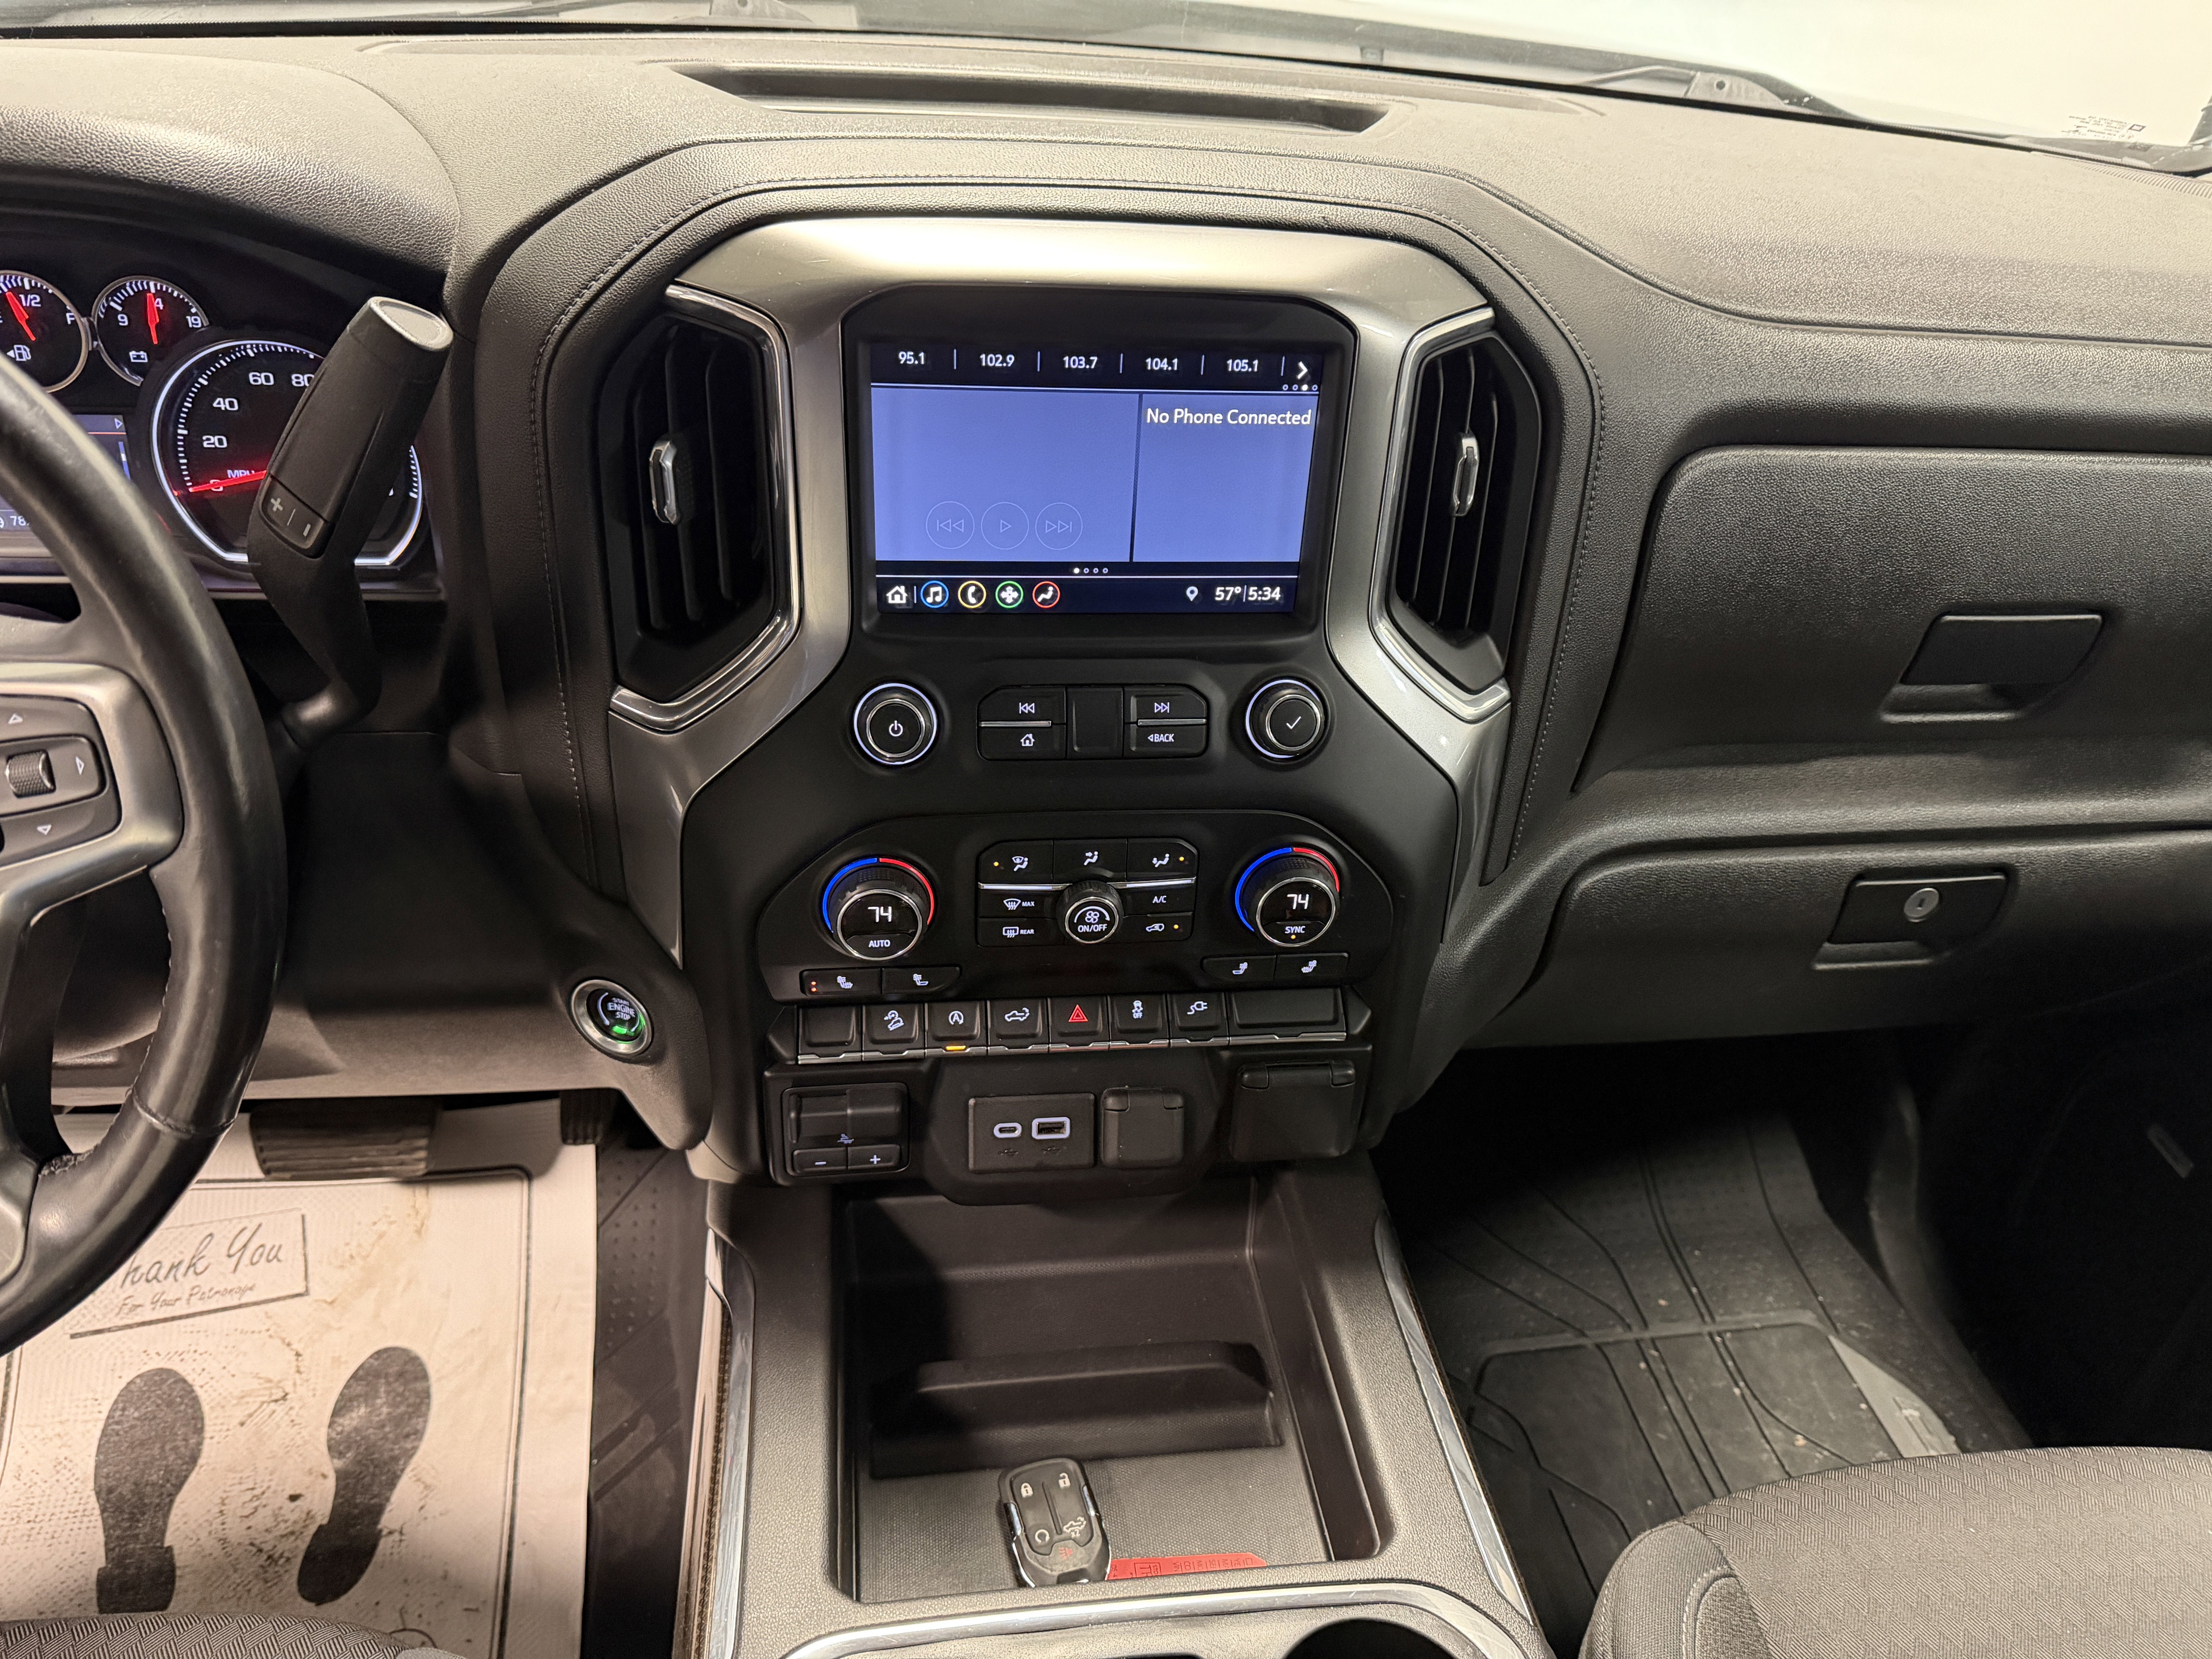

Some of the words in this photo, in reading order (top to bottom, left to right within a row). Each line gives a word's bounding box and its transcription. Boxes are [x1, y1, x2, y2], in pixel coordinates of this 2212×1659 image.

[19, 294, 41, 307] 1/2
[66, 313, 75, 325] F
[117, 314, 129, 326] 9
[186, 316, 202, 328] 19
[898, 351, 925, 365] 95.1
[980, 353, 1015, 367] 102.9
[1063, 355, 1098, 369] 103.7
[1146, 357, 1178, 371] 104.1
[1227, 359, 1259, 372] 105.1
[249, 372, 274, 385] 60
[213, 397, 239, 411] 40
[1147, 408, 1170, 423] No
[1173, 408, 1223, 424] Phone
[1227, 409, 1312, 425] Connected
[202, 435, 228, 448] 20
[1215, 586, 1242, 601] 57°
[1248, 586, 1281, 601] 5:34
[1154, 733, 1175, 742] BACK
[1152, 895, 1167, 903] A/C
[1287, 894, 1309, 910] 74
[867, 906, 892, 922] 74
[1077, 924, 1108, 933] ON/OFF
[1285, 925, 1306, 934] SYNC
[868, 939, 891, 948] AUTO
[612, 997, 630, 1006] START
[607, 1002, 635, 1017] ENGINE
[616, 1012, 630, 1020] STOP
[120, 1232, 214, 1288] hank
[227, 1222, 283, 1274] You
[117, 1295, 143, 1316] For
[150, 1291, 182, 1311] Your
